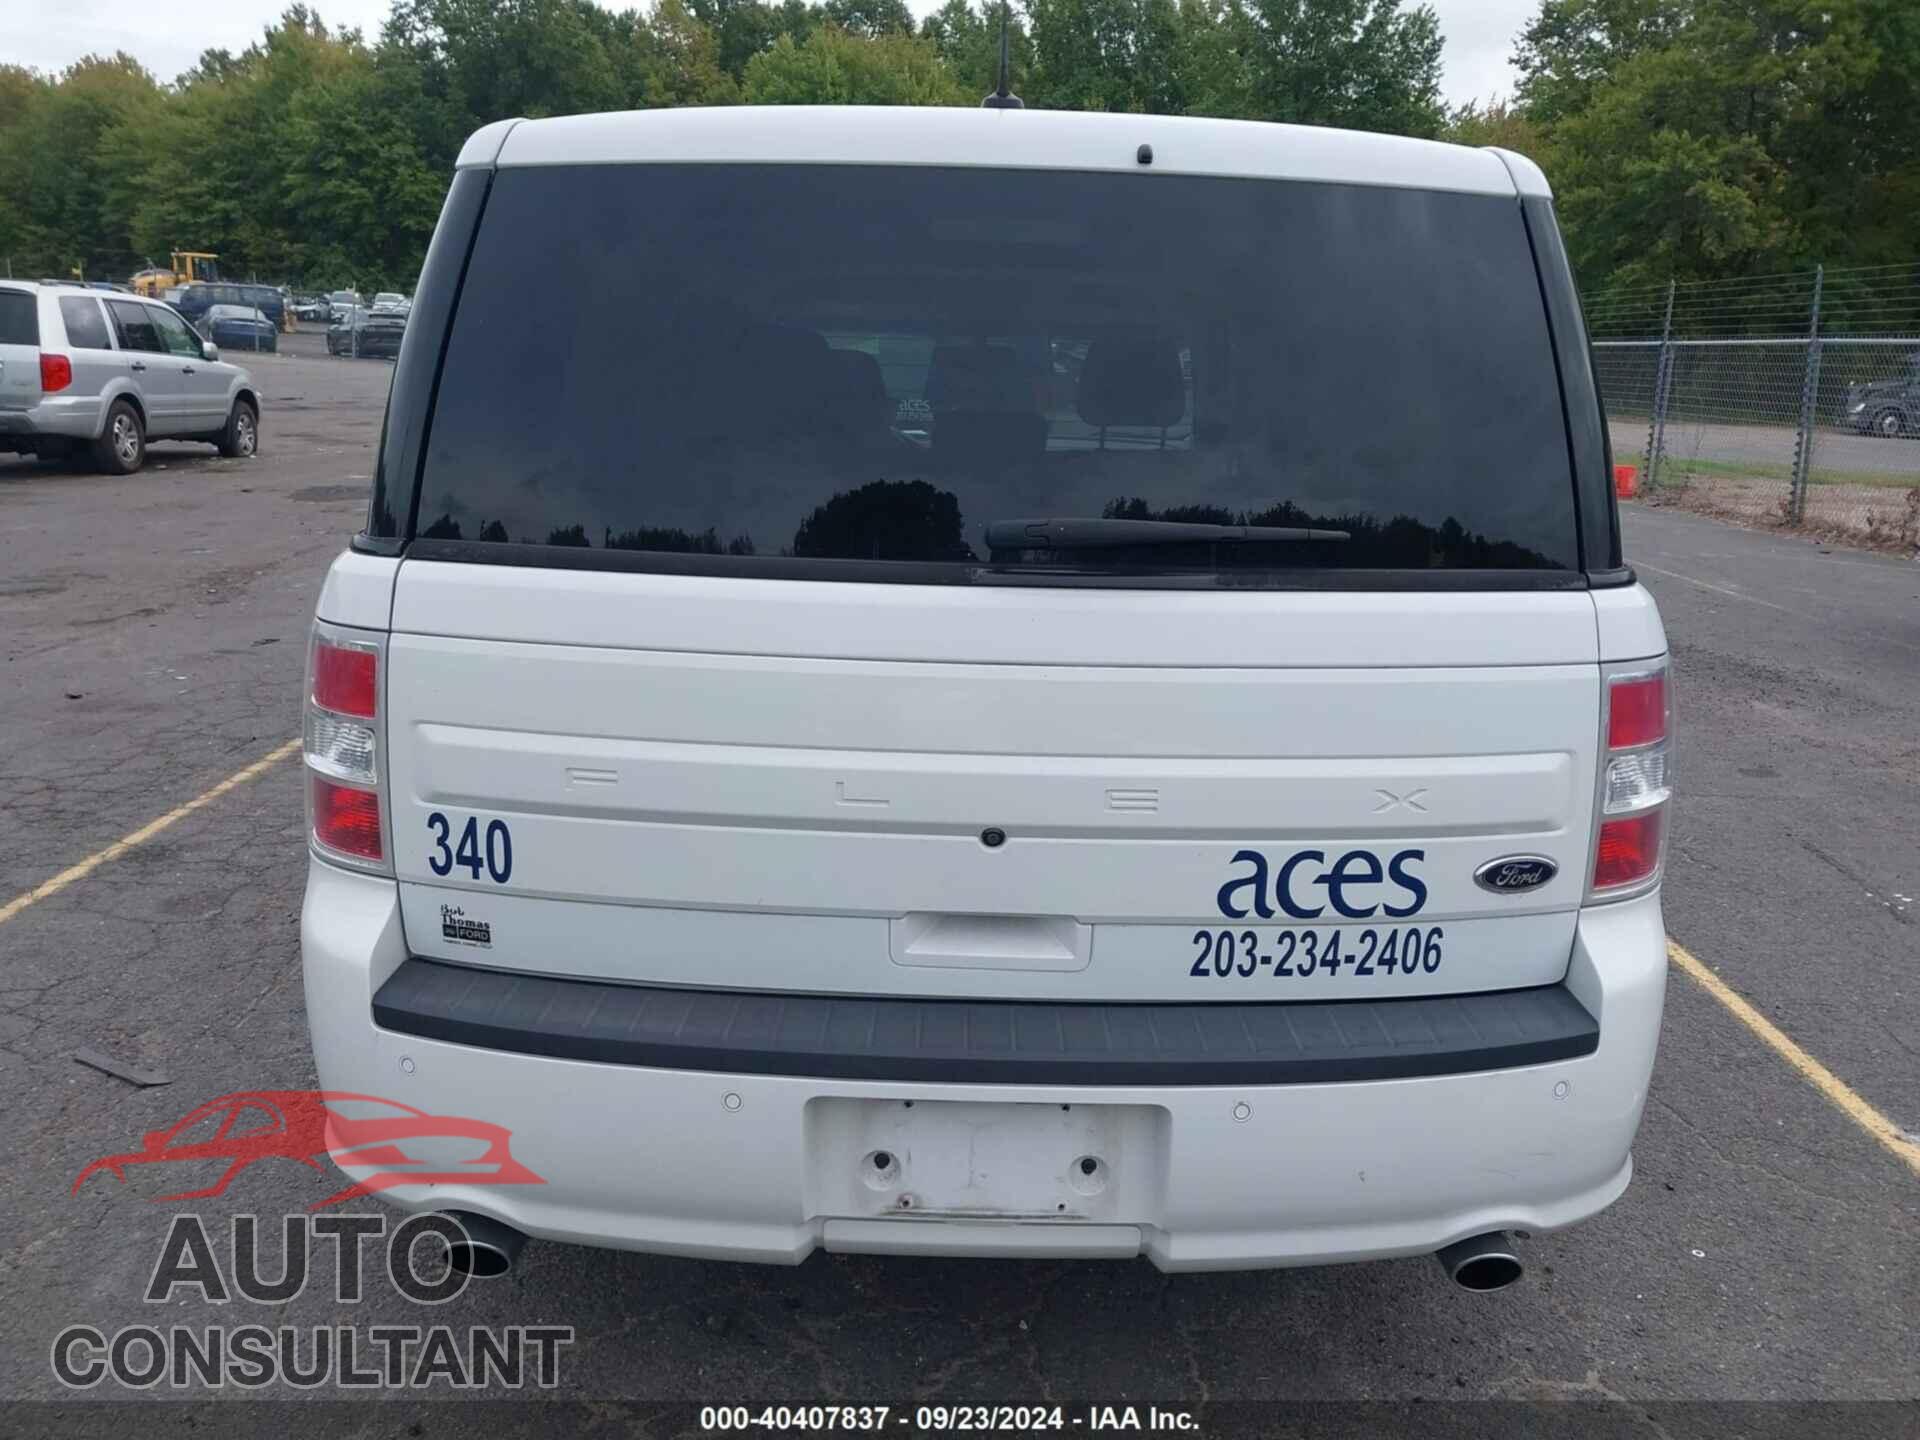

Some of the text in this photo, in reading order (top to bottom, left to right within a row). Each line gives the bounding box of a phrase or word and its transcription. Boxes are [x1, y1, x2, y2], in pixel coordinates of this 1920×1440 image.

[427, 812, 512, 884] 340
[1217, 849, 1427, 919] aces
[1496, 863, 1544, 886] Ford
[442, 914, 490, 930] Thomas
[459, 929, 489, 941] FORD
[1190, 926, 1444, 978] 203-234-2406
